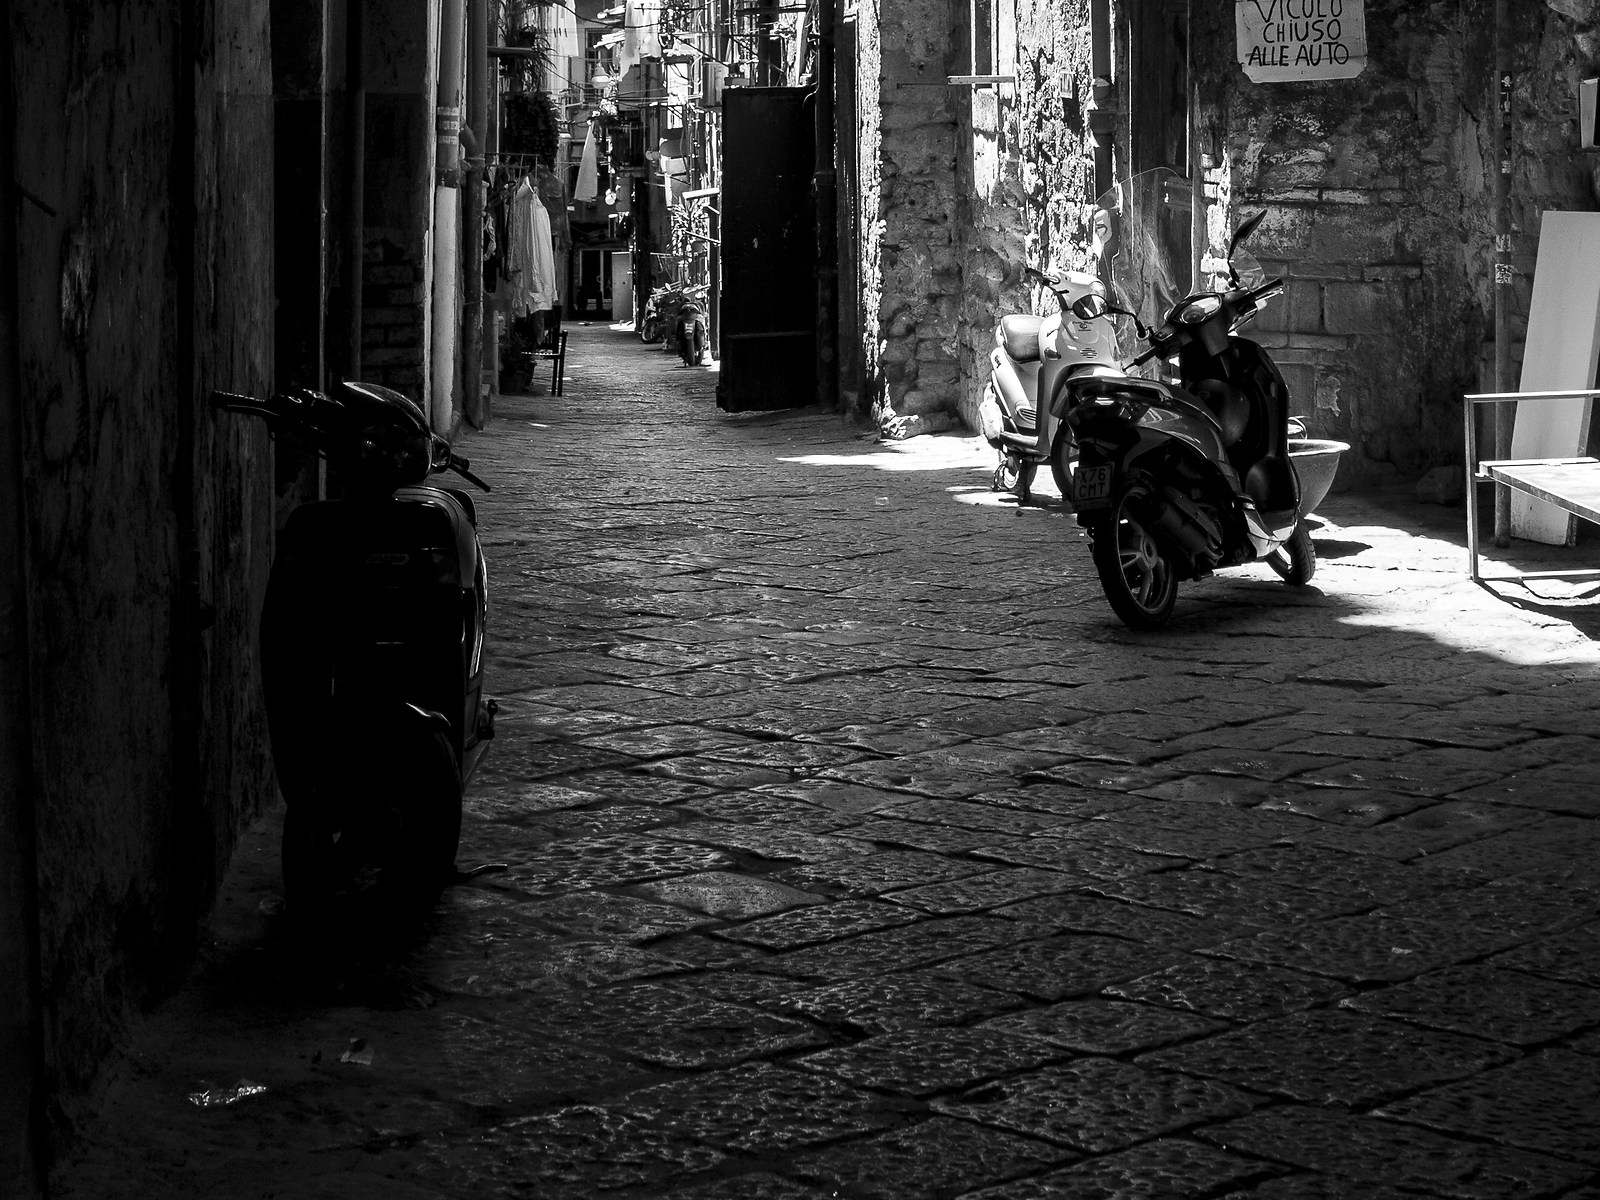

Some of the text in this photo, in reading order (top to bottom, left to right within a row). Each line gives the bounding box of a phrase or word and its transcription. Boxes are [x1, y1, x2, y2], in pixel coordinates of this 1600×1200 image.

[1248, 41, 1349, 67] ALLE AUTO
[1080, 467, 1106, 484] X76
[1079, 482, 1106, 498] CMT
